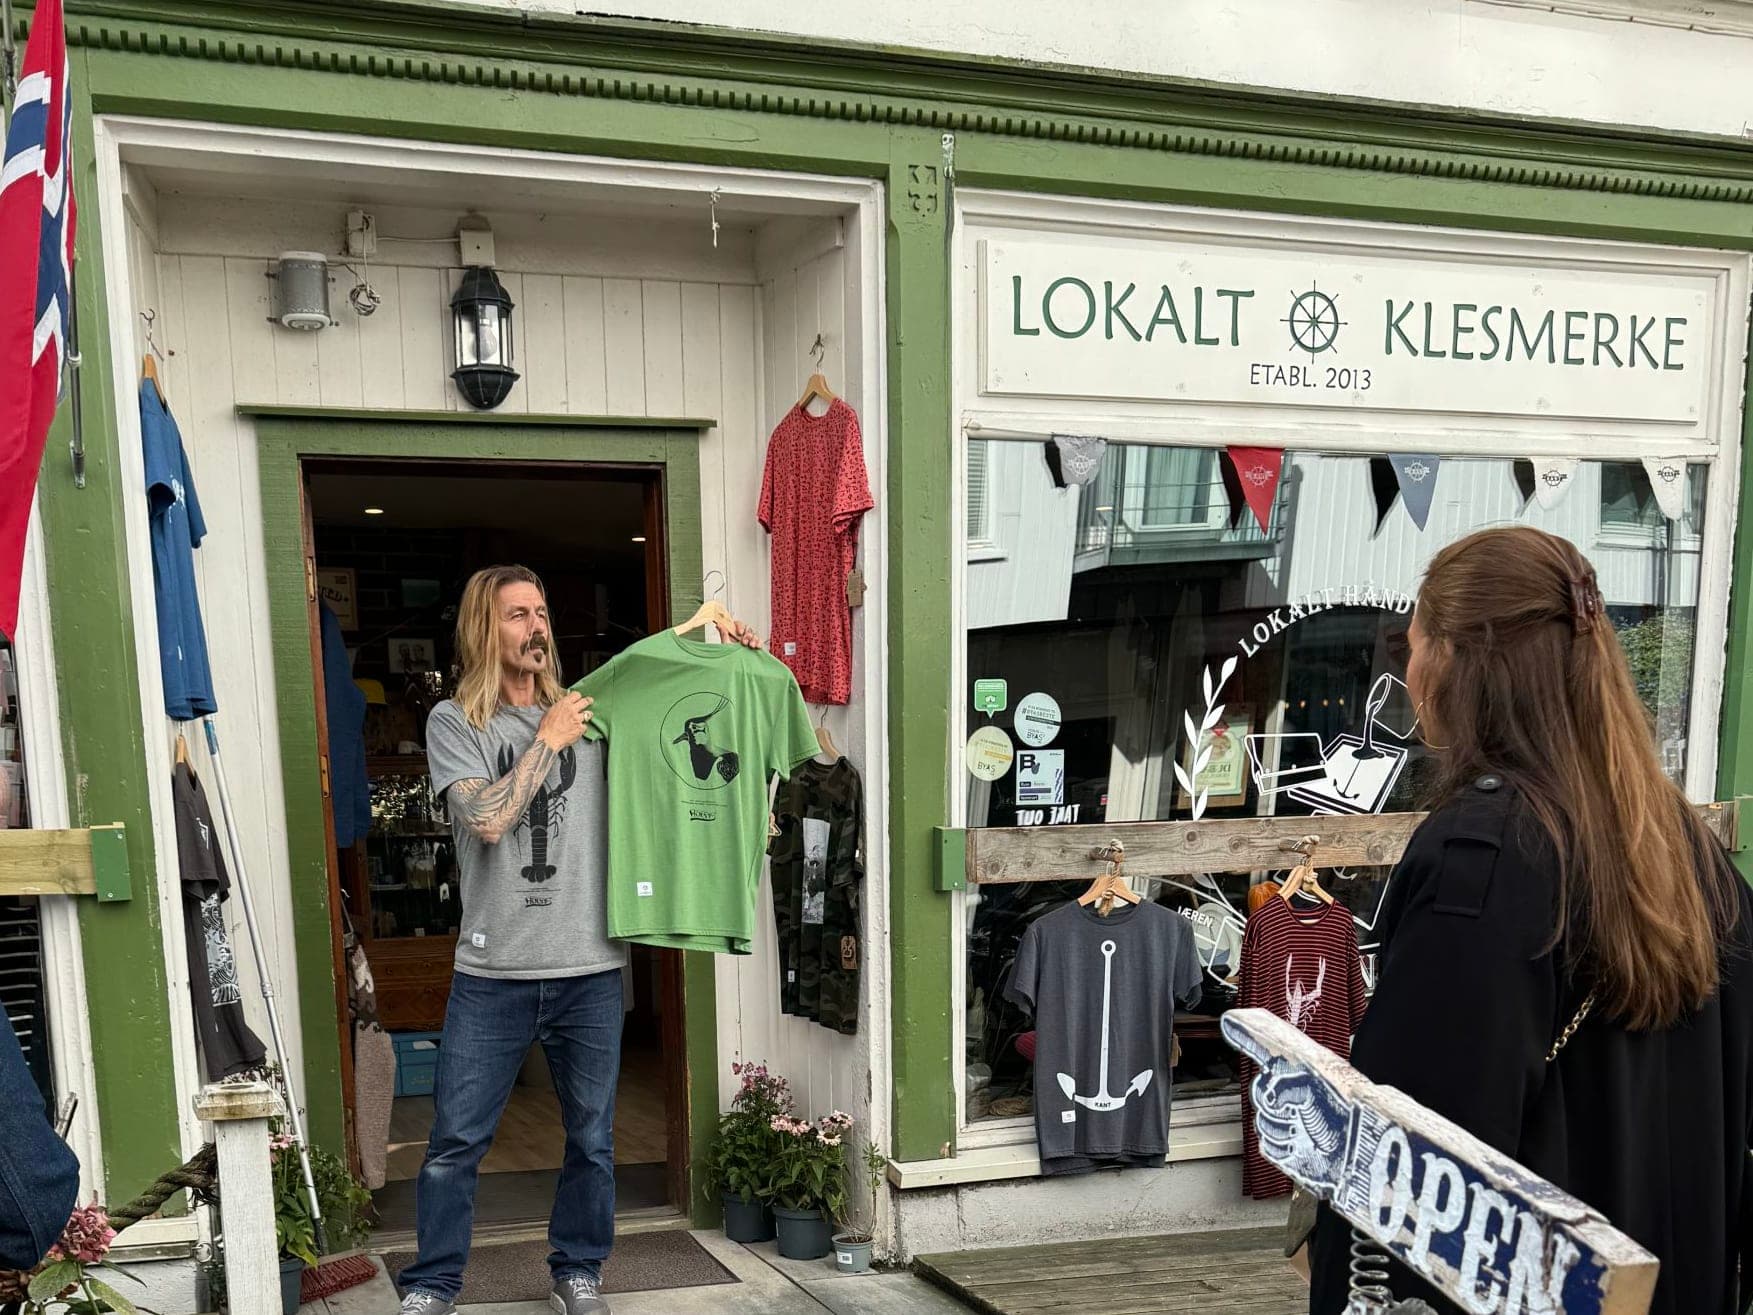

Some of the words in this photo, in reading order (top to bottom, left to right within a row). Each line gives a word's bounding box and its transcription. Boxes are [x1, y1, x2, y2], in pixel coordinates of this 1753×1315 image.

[1012, 275, 1254, 348] LOKALT
[1385, 299, 1687, 370] KLESMERKE
[1250, 364, 1317, 388] ETABL.
[1326, 366, 1372, 391] 2013
[1238, 587, 1334, 658] LOKALT
[1369, 1126, 1581, 1315] OPEN
